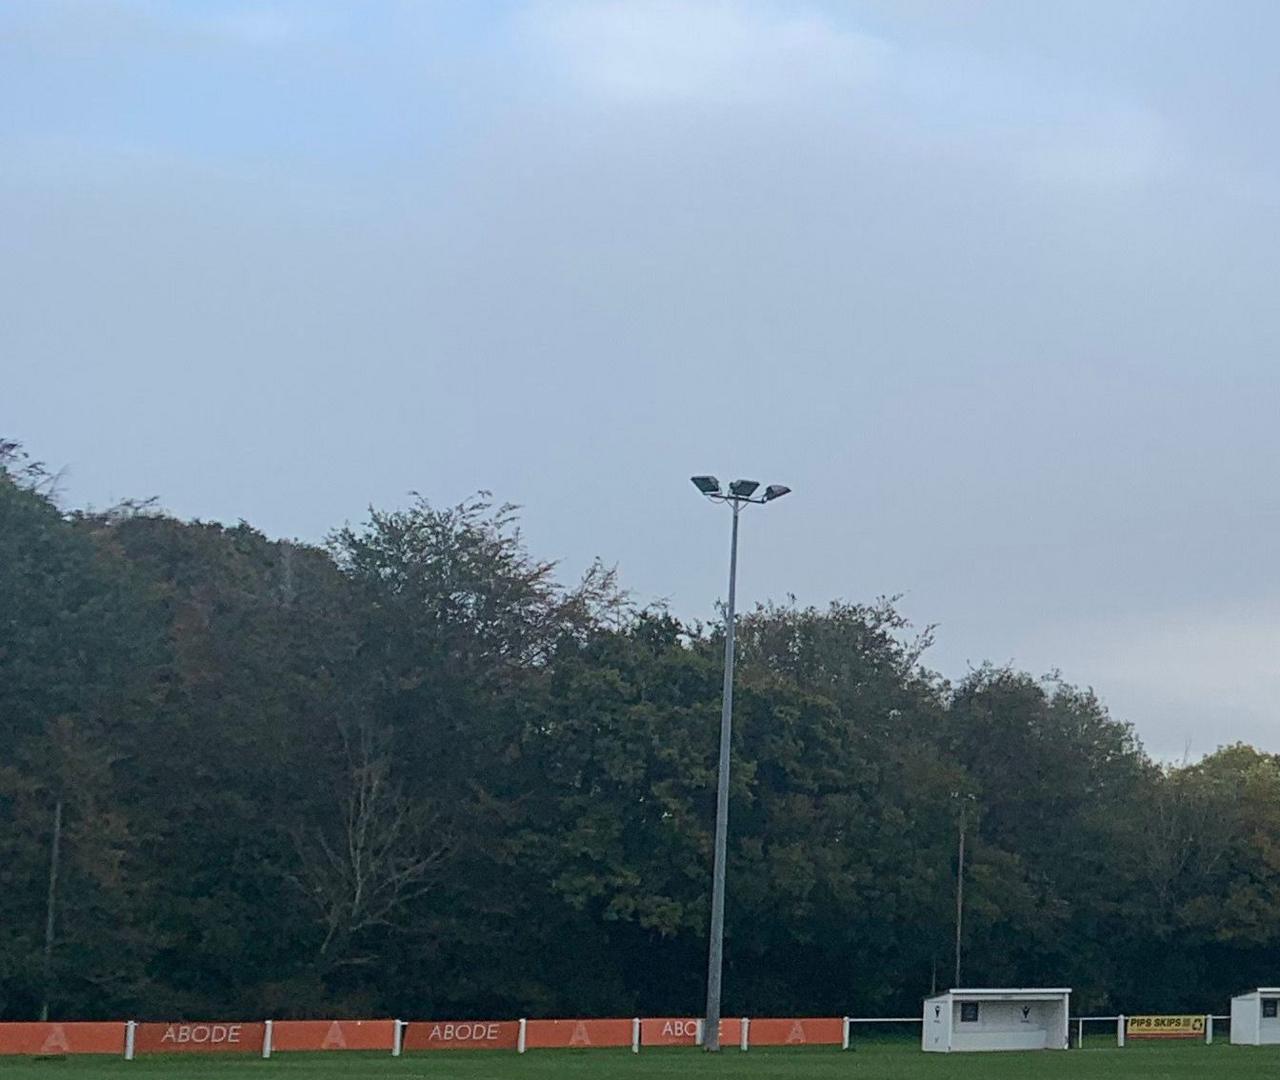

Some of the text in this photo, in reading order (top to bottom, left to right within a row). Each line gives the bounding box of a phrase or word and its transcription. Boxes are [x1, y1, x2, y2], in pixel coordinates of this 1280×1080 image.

[662, 1021, 722, 1037] ABO
[1130, 1018, 1152, 1028] PIPS
[1154, 1018, 1181, 1028] SKIPS
[161, 1025, 242, 1043] ABODE
[429, 1024, 500, 1041] ABODE
